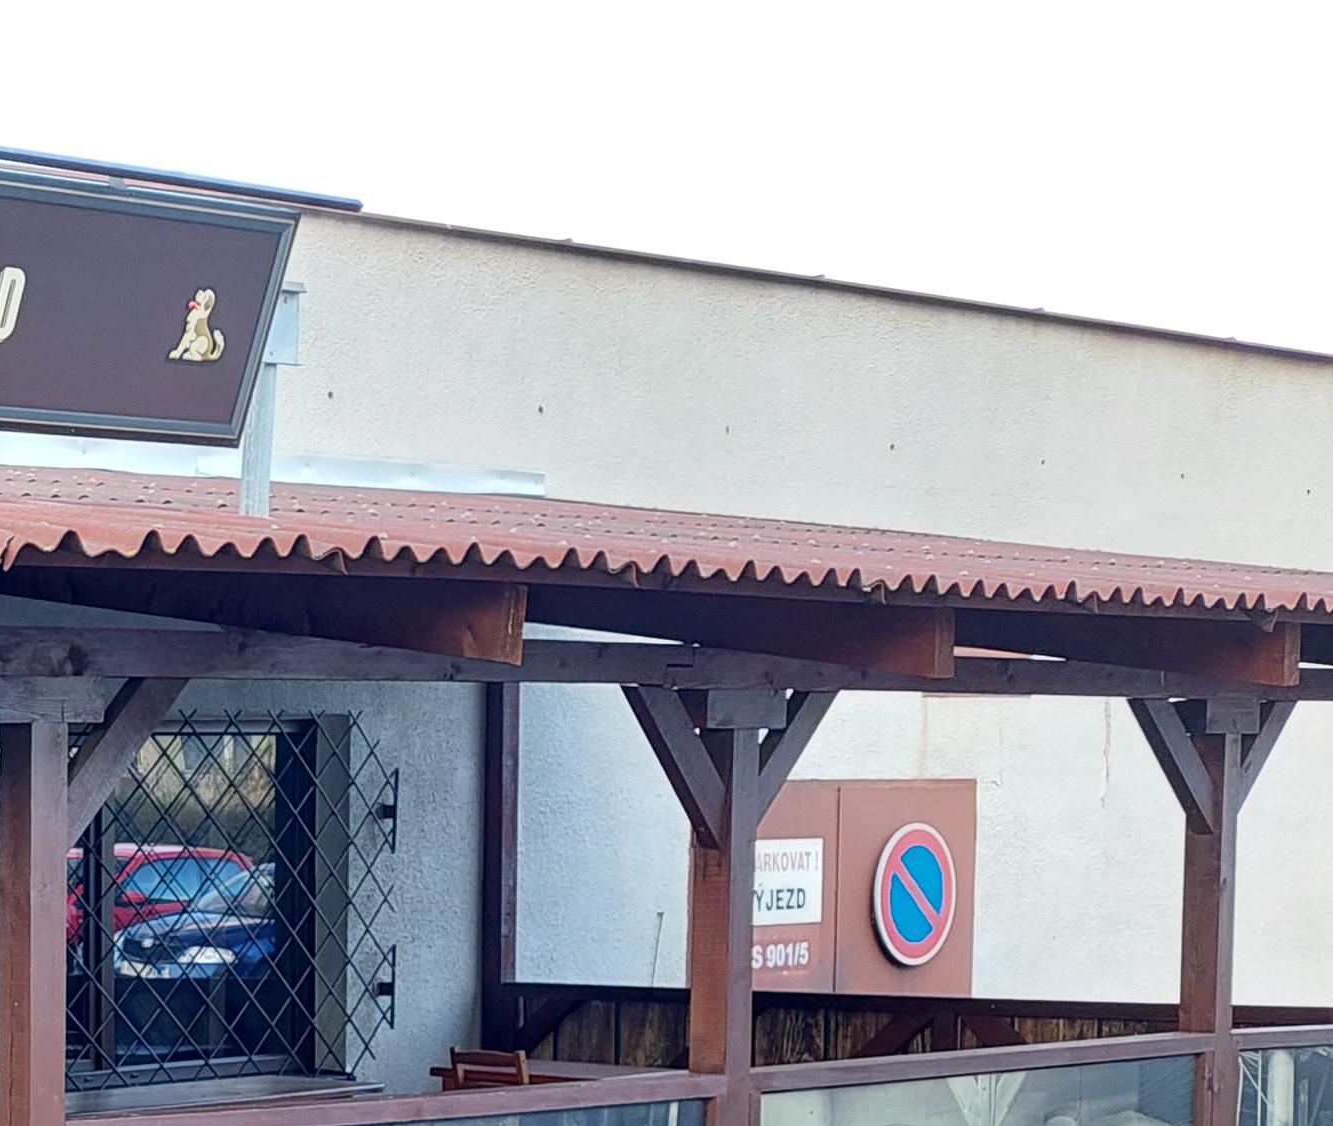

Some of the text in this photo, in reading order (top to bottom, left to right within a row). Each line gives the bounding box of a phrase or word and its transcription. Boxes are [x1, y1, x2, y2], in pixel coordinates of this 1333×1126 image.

[756, 851, 811, 873] ARKOVAT
[753, 883, 806, 912] ÝJEZD
[766, 942, 809, 968] 901/5
